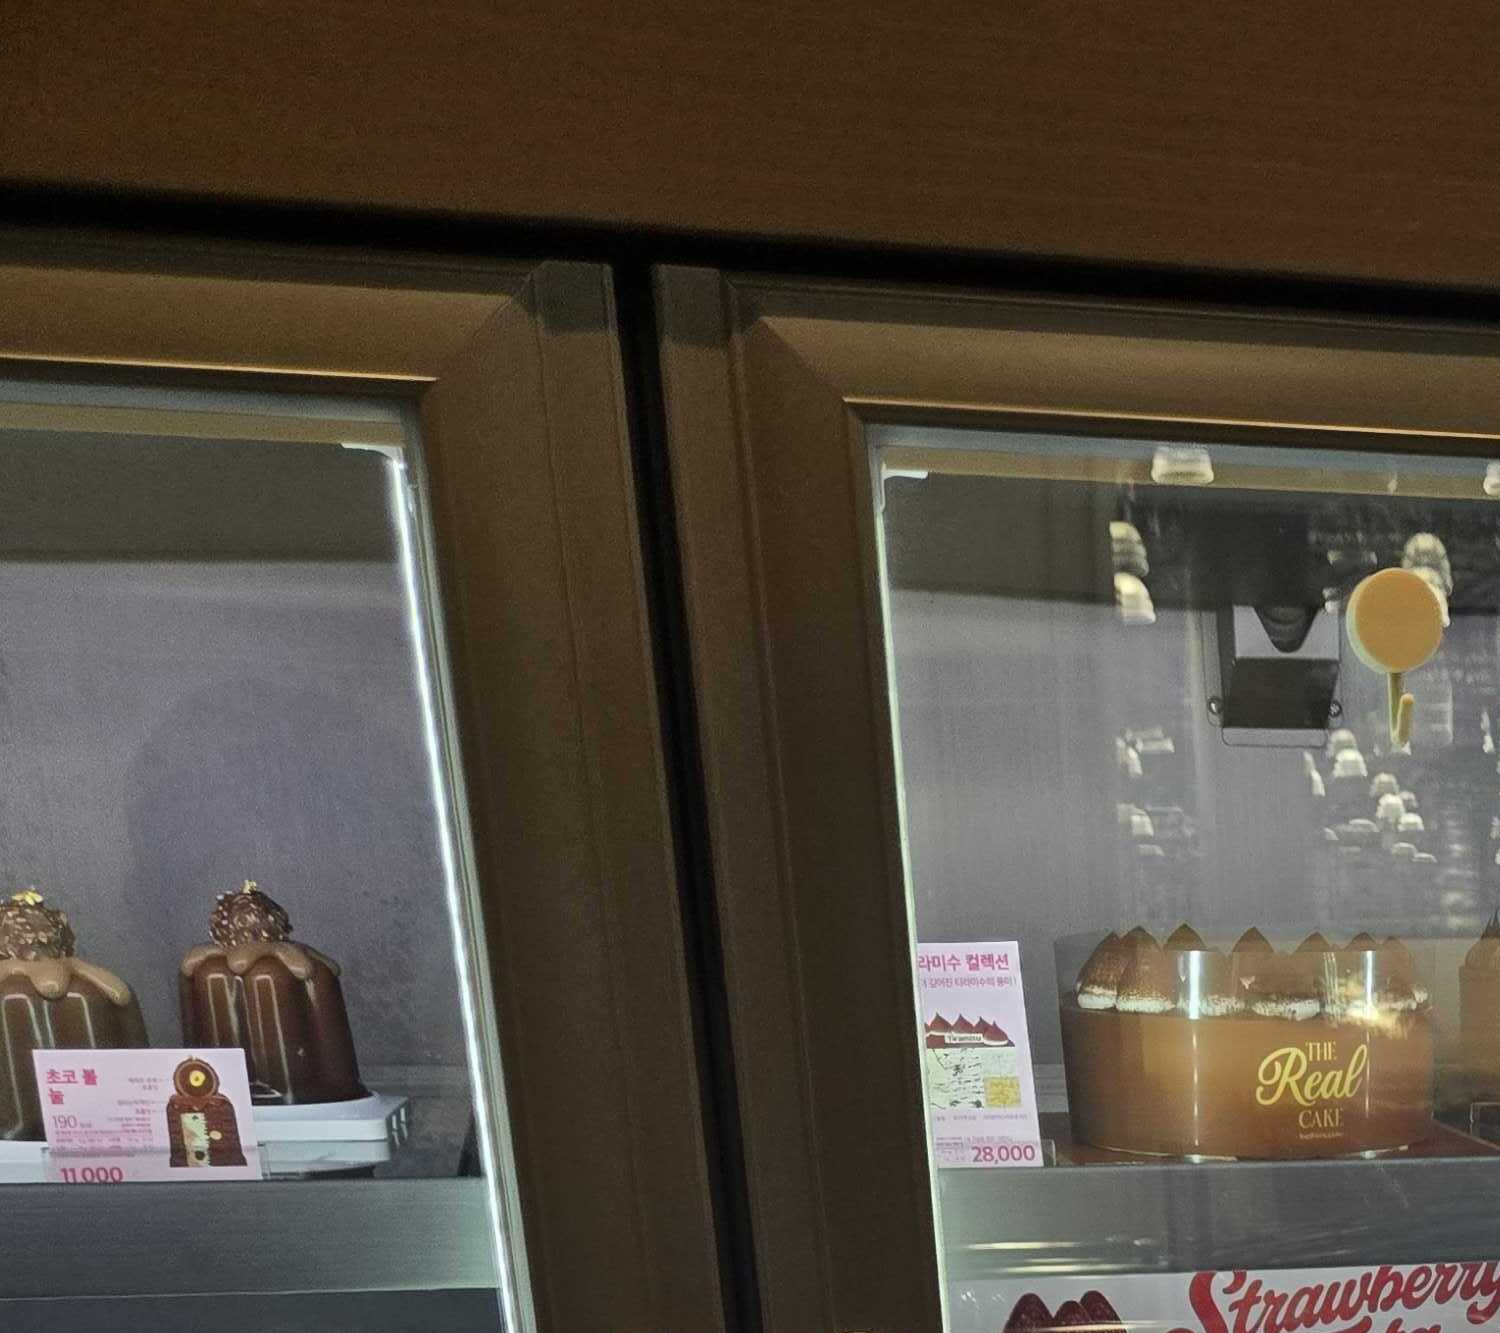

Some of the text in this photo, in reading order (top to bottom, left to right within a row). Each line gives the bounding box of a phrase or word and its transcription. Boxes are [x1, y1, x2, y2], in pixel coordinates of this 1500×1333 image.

[918, 953, 1009, 973] 라미수 컬렉션
[1306, 1041, 1337, 1062] THE
[47, 1069, 77, 1084] 초코
[1256, 1044, 1368, 1106] Real
[1298, 1107, 1344, 1129] CAKE
[972, 1144, 1035, 1164] 28,000
